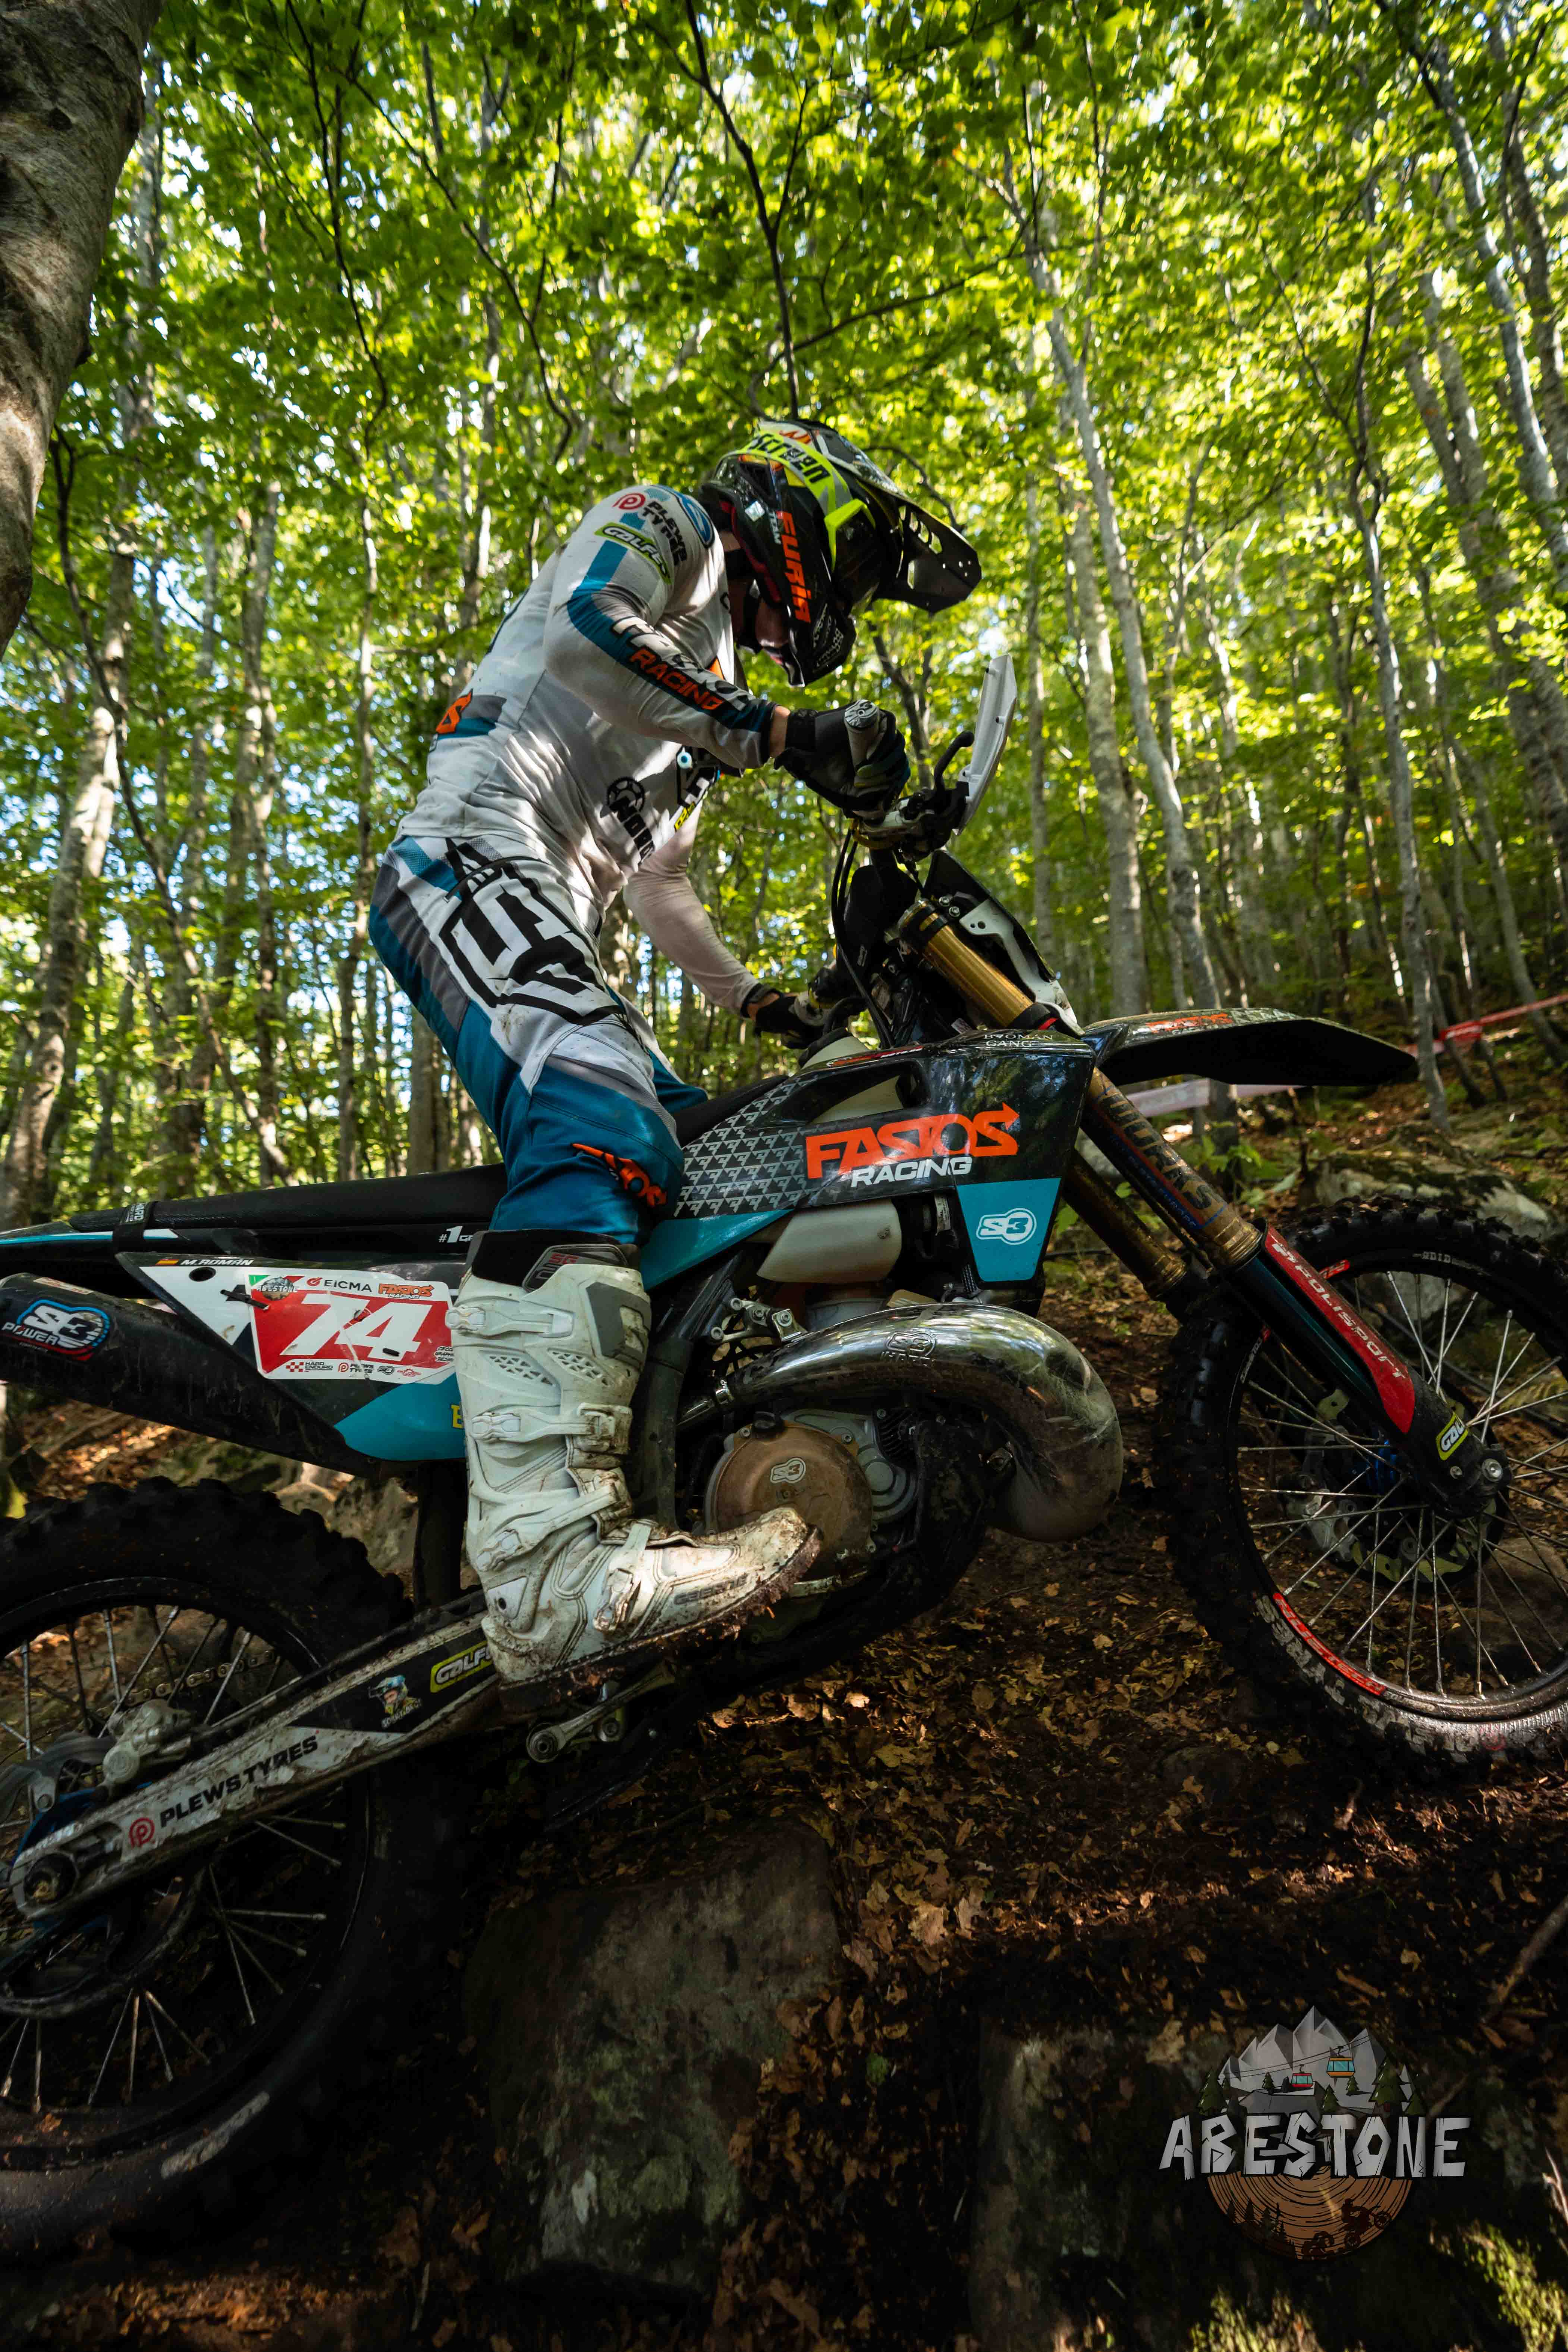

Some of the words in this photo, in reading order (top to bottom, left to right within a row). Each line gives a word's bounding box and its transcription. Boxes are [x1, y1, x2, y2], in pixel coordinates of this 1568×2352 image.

[630, 648, 724, 710] RACING
[806, 1102, 1020, 1179] FASTOS
[851, 1156, 972, 1188] RACING
[977, 1209, 1036, 1243] S3
[324, 1279, 372, 1293] EICMA
[378, 1283, 435, 1297] FASTOS
[1, 1322, 59, 1345] POWER
[23, 1305, 103, 1348] S3
[280, 1293, 431, 1362] 74
[160, 1774, 241, 1828] PLEWS
[244, 1735, 318, 1784] TYRES
